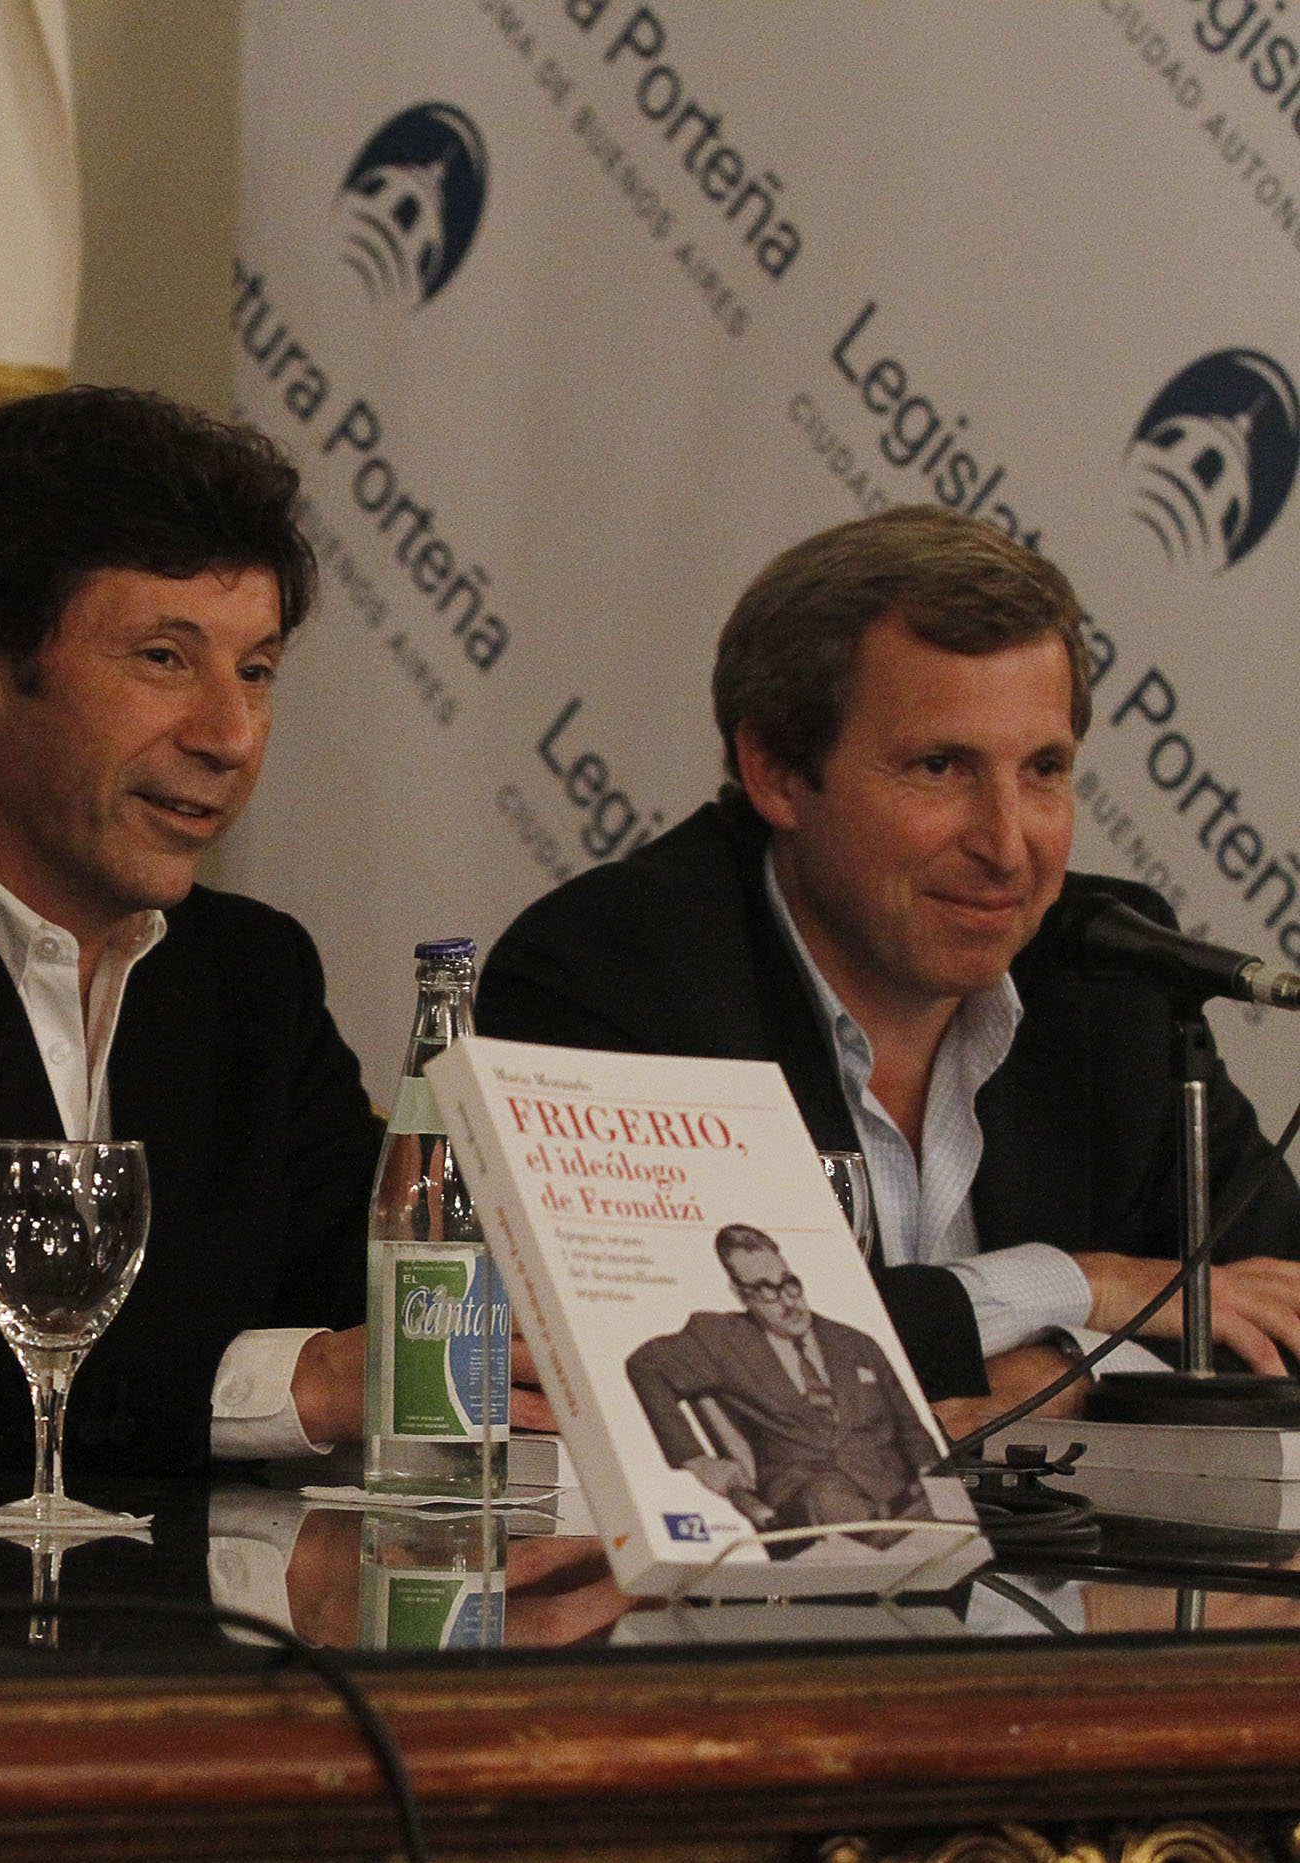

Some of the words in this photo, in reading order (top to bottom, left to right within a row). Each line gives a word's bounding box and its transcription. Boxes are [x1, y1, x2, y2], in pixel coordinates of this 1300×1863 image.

[1188, 0, 1300, 140] gisl
[603, 5, 801, 280] Porteña
[1203, 112, 1300, 253] AUTON
[321, 398, 512, 673] Porteña
[505, 1096, 749, 1157] FRIGERIO,
[525, 1142, 553, 1174] el
[556, 1146, 688, 1192] ideólogo
[540, 1181, 574, 1213] de
[403, 1274, 419, 1285] EL
[404, 1289, 509, 1338] Cántaro
